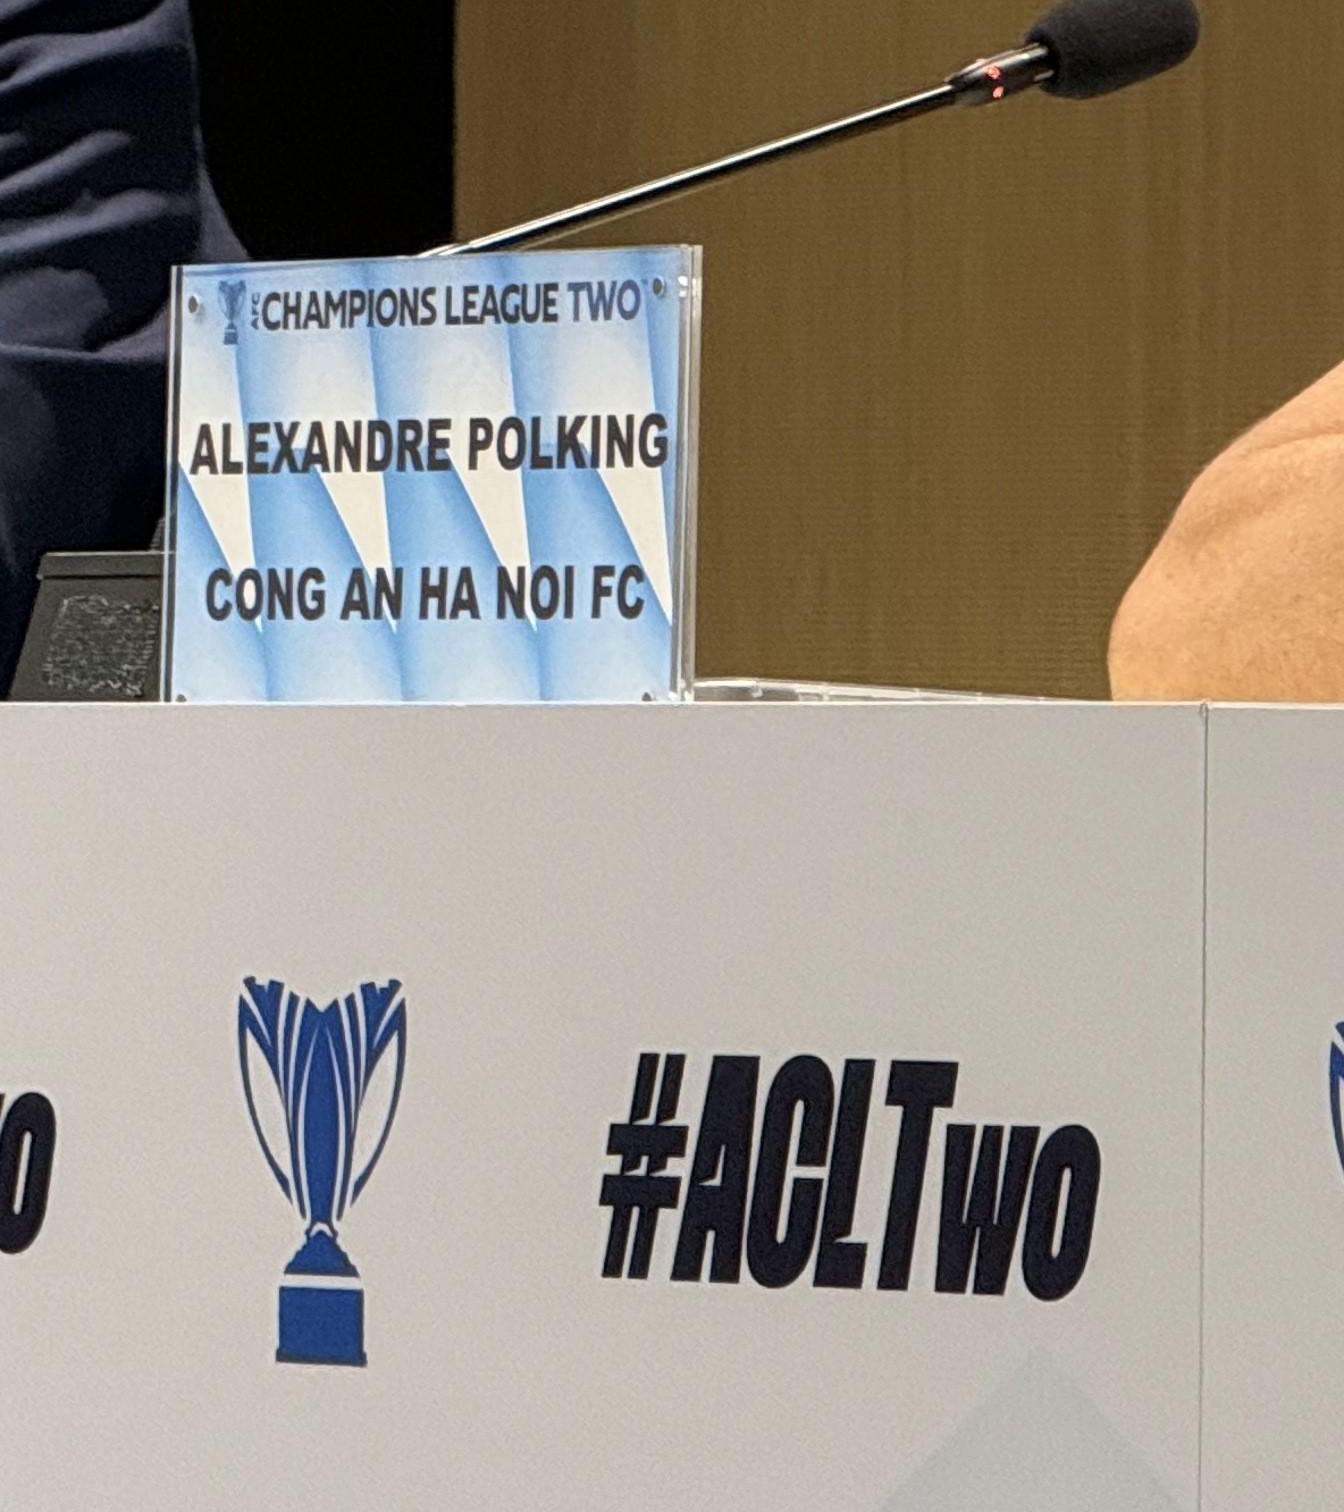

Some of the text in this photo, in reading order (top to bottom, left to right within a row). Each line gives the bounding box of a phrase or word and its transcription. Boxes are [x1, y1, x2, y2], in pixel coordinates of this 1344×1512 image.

[262, 287, 438, 331] CHAMPIONS
[444, 283, 560, 325] LEAGUE
[189, 413, 668, 476] ALEXANDRE POLKING
[205, 563, 646, 621] CONG AN HA NOI FC
